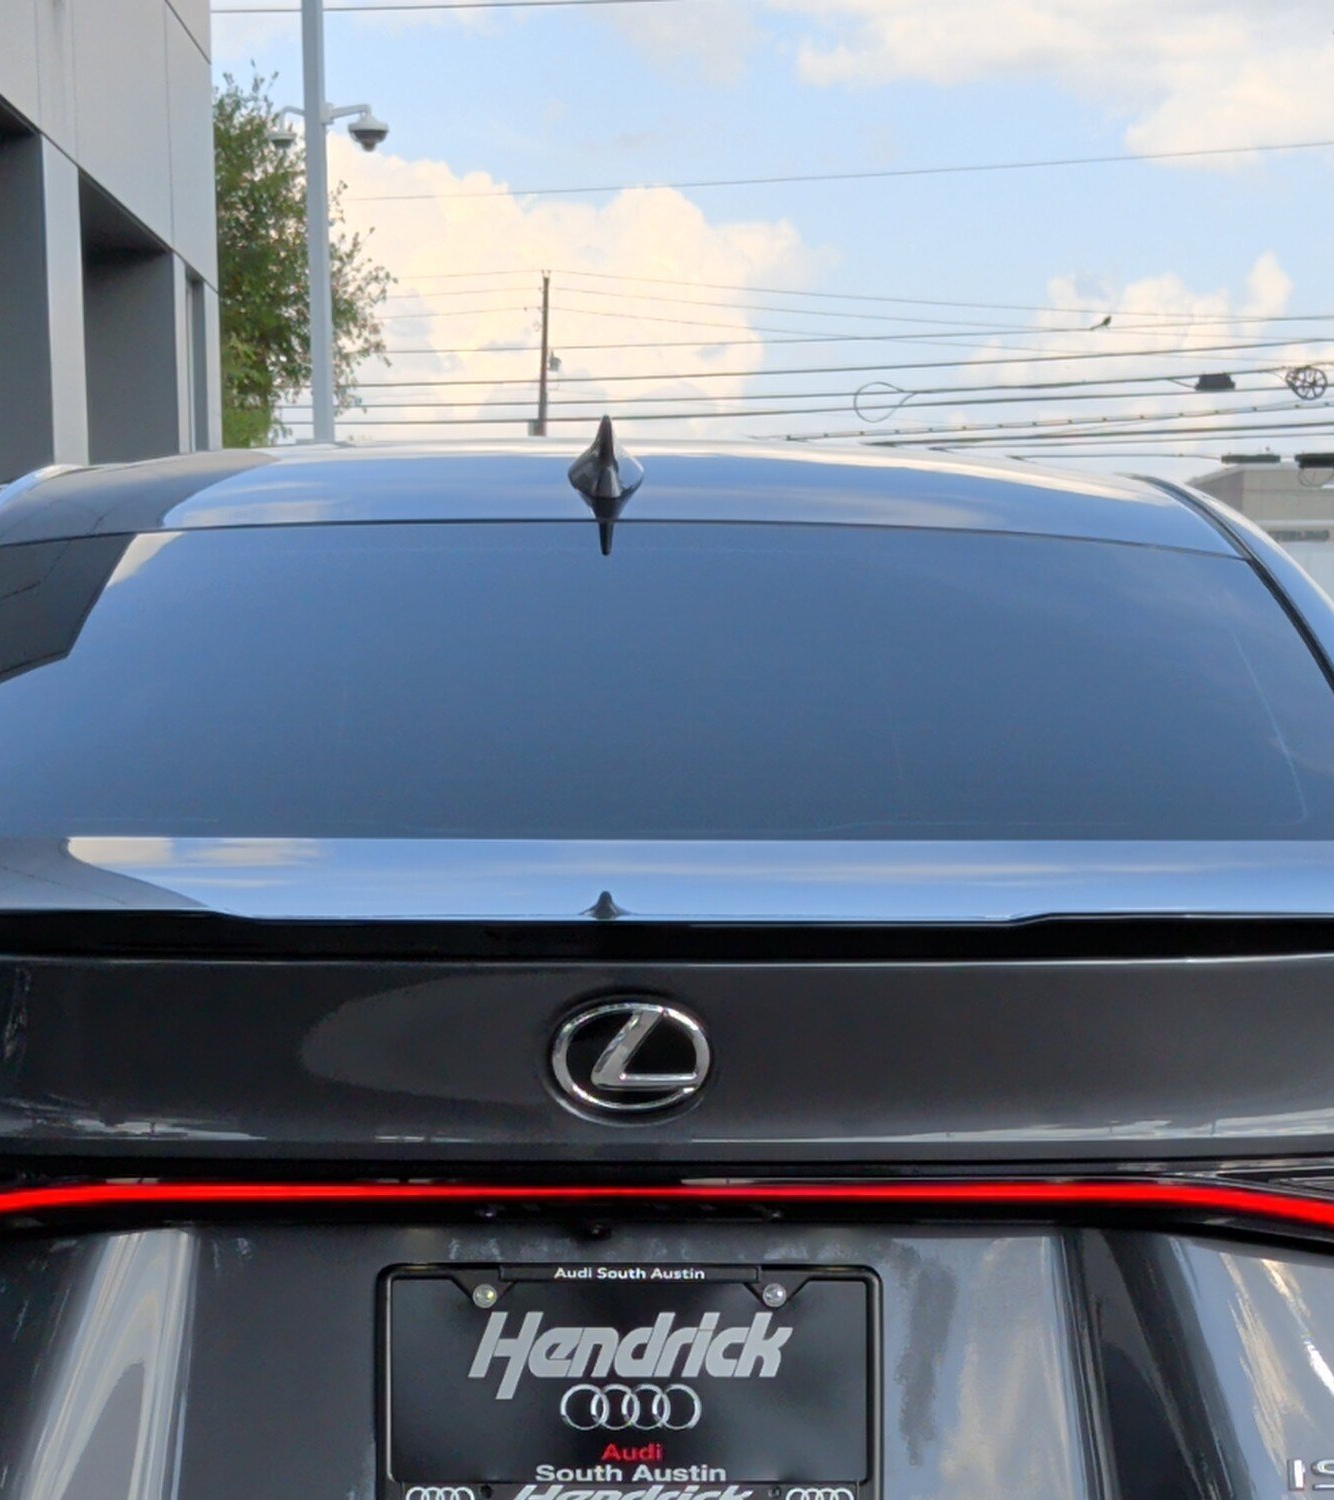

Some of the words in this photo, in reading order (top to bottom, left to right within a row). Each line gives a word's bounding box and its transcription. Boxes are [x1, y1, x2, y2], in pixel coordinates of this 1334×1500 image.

[554, 1267, 593, 1279] Audi
[597, 1267, 646, 1279] South
[651, 1268, 706, 1280] Austin
[468, 1311, 793, 1399] Hendrick
[601, 1443, 663, 1461] Audi
[535, 1464, 623, 1482] South
[631, 1464, 727, 1482] Austin
